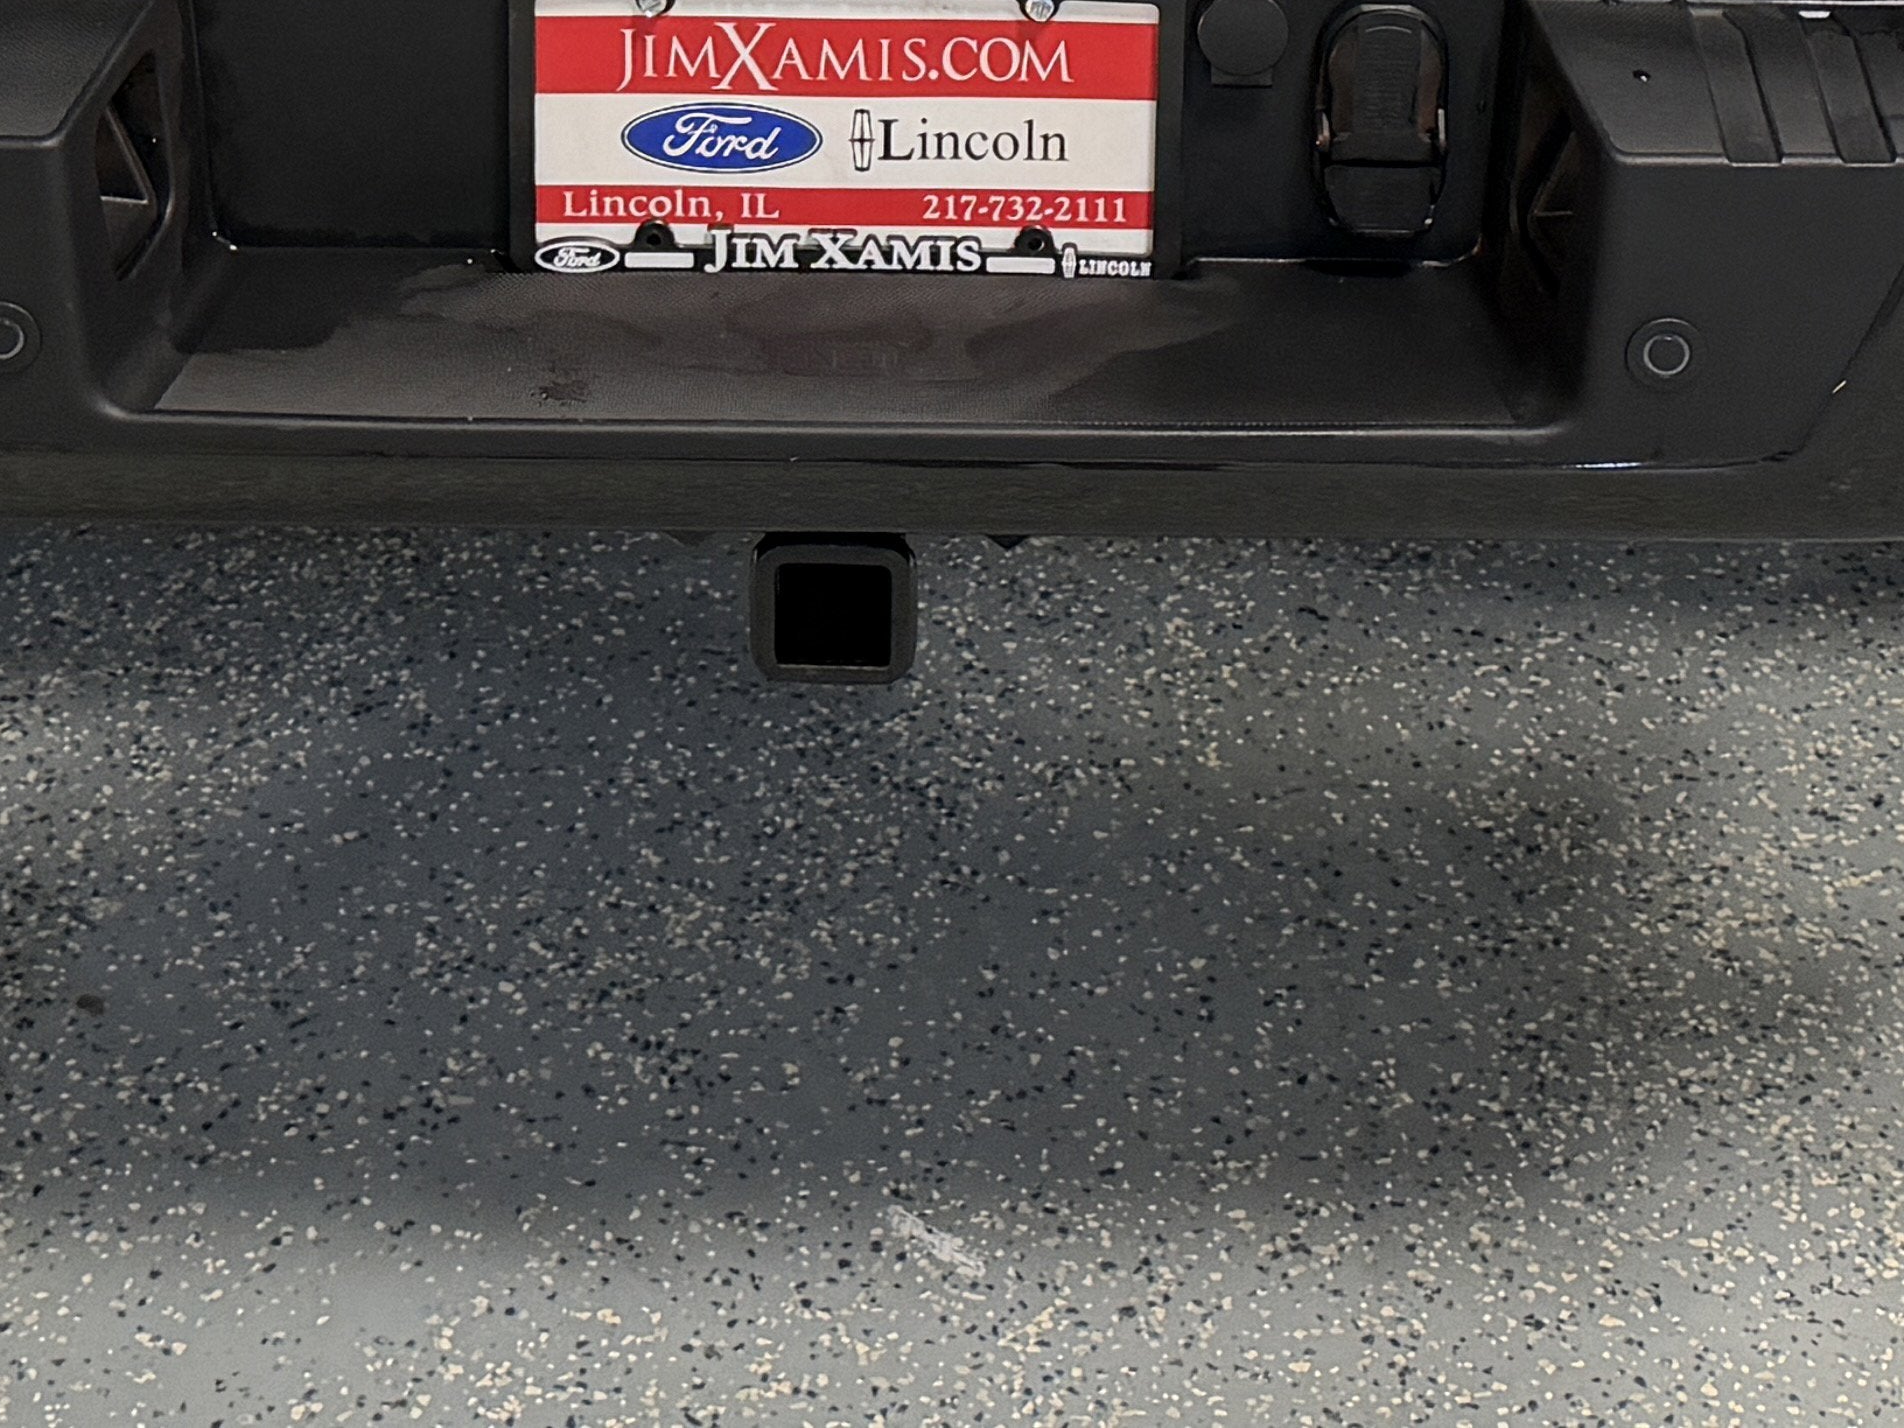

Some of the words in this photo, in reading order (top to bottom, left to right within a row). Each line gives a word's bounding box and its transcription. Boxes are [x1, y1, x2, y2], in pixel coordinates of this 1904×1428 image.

[662, 112, 783, 162] Ford
[877, 118, 1069, 163] Lincoln
[562, 189, 724, 222] Lincoln,
[740, 192, 780, 219] IL
[921, 194, 1127, 223] 217-732-2111
[552, 246, 601, 269] Ford
[1077, 258, 1152, 278] LINCOLN
